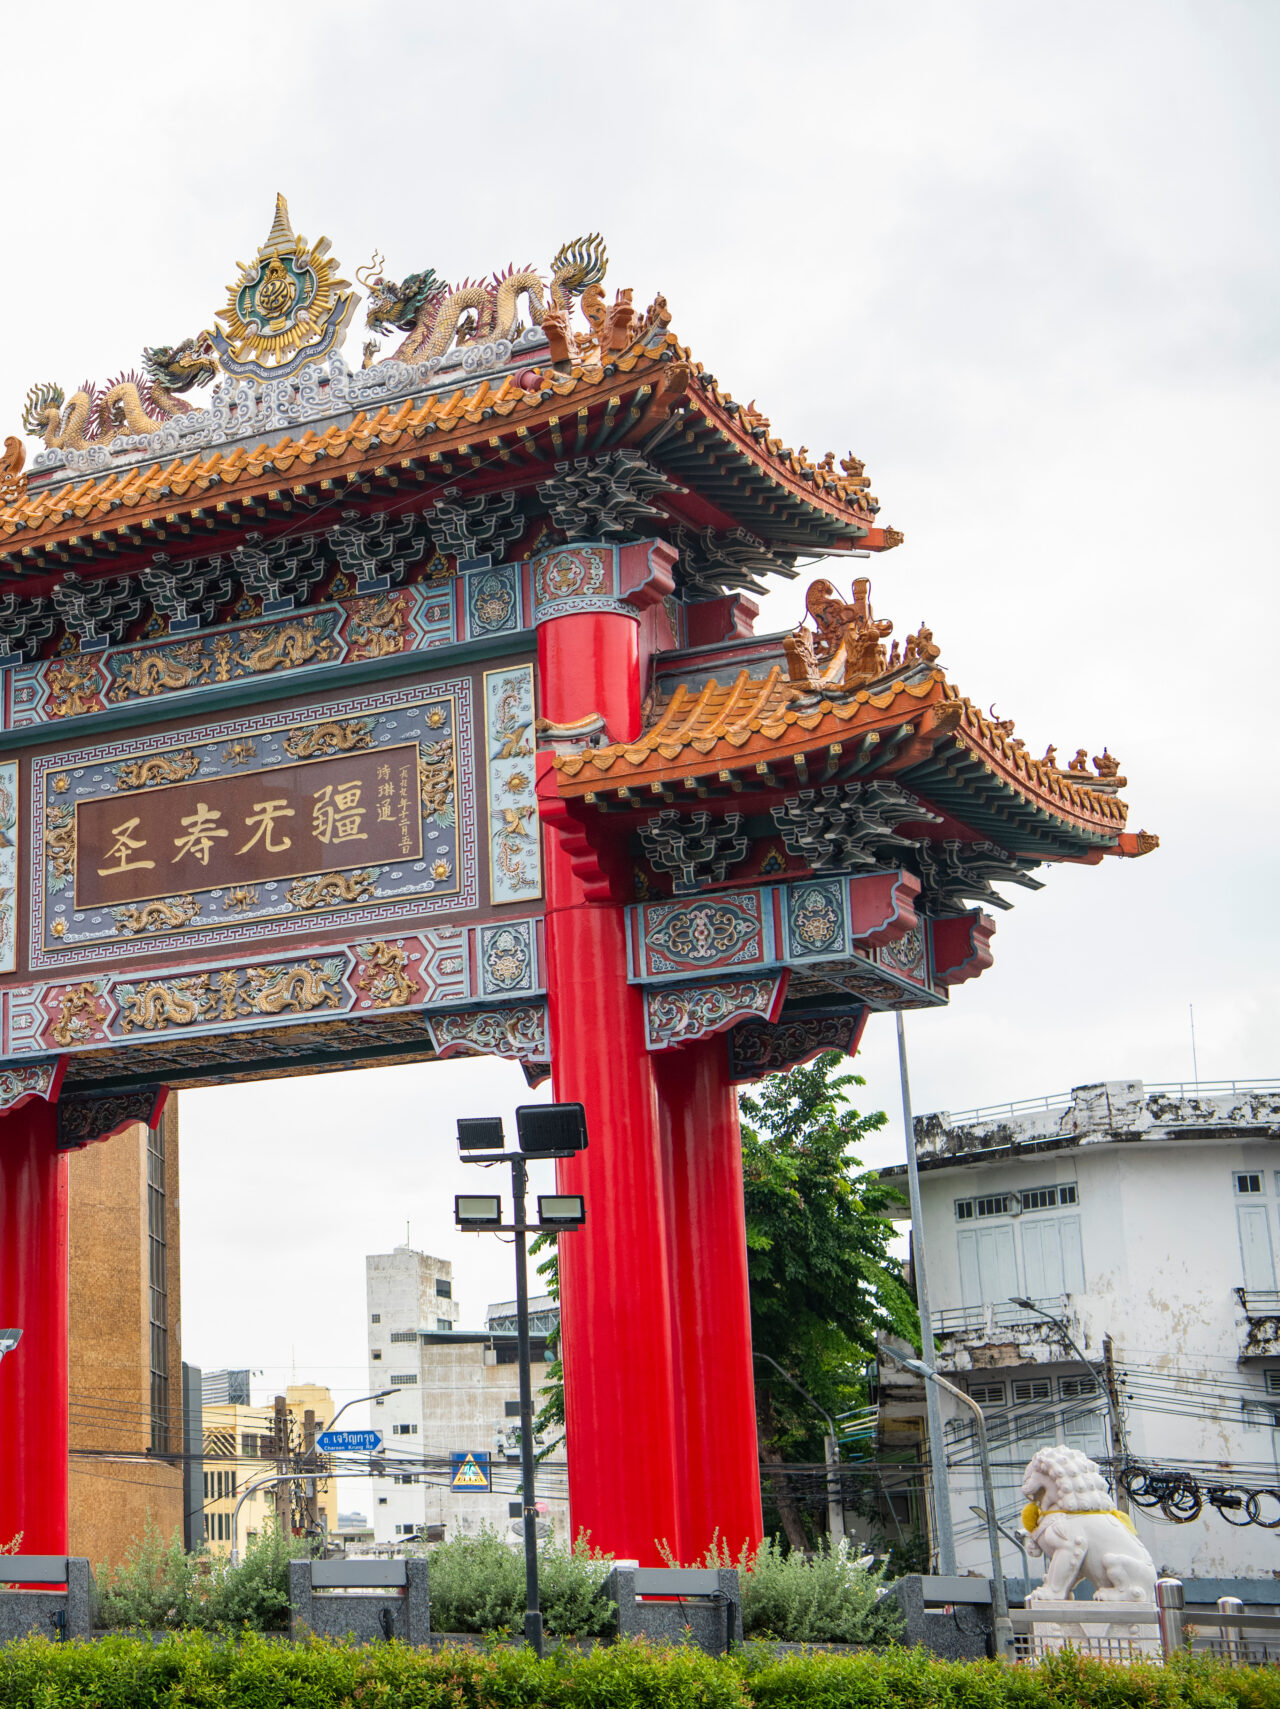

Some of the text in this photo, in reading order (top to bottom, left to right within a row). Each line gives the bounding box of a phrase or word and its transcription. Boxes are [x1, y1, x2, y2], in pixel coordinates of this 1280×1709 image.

[97, 780, 368, 876] 圣寿无疆
[333, 1432, 375, 1446] เจริญกรุง
